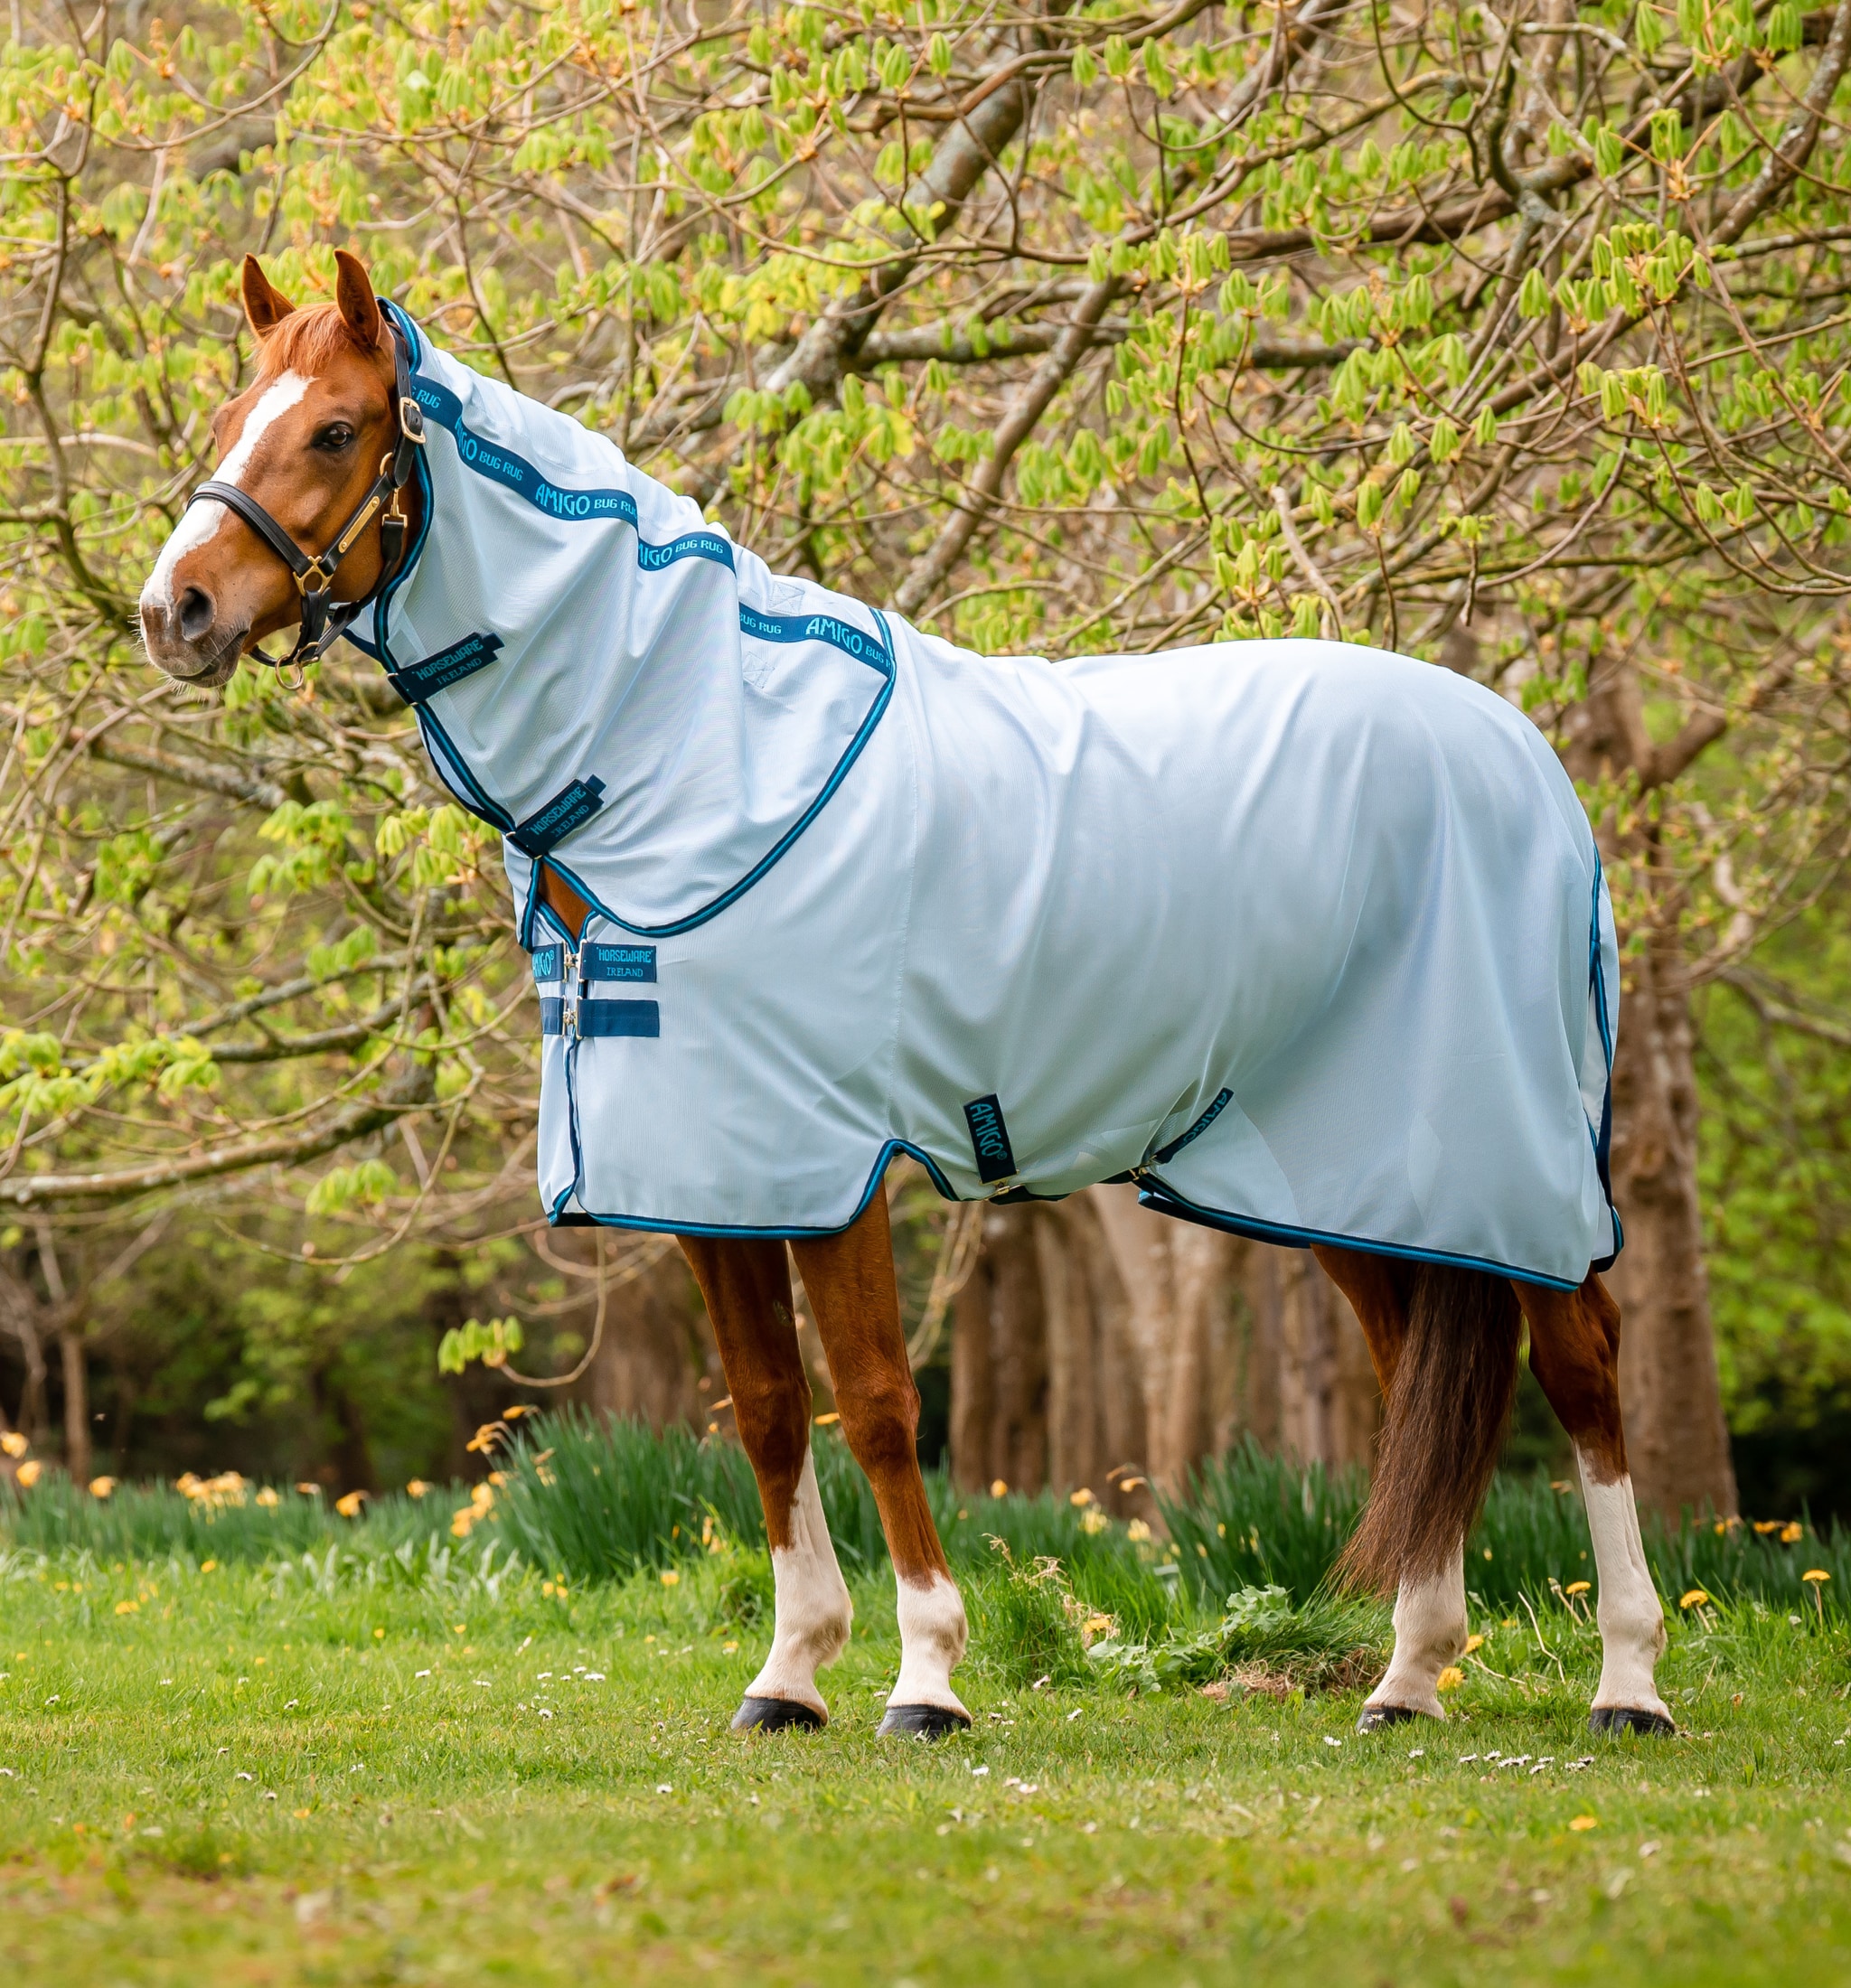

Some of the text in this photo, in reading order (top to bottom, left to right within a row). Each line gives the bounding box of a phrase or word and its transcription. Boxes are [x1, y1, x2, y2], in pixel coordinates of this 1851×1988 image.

[416, 389, 442, 408] RUG
[479, 450, 502, 469] BUG
[503, 462, 524, 481] RUG
[535, 483, 590, 516] AMIGO
[594, 498, 618, 509] BUG
[675, 539, 698, 553] BUG
[700, 539, 723, 554] RUG
[759, 622, 782, 634] RUG
[805, 617, 863, 654] AMIGO
[865, 644, 885, 663] BUG
[416, 639, 484, 680] HORSEWARE
[436, 657, 483, 685] IRELAND
[530, 786, 587, 836] HORSEWARE
[550, 804, 589, 837] IRELAND
[598, 948, 652, 963] HORSEWARE
[606, 966, 644, 978] IRELAND
